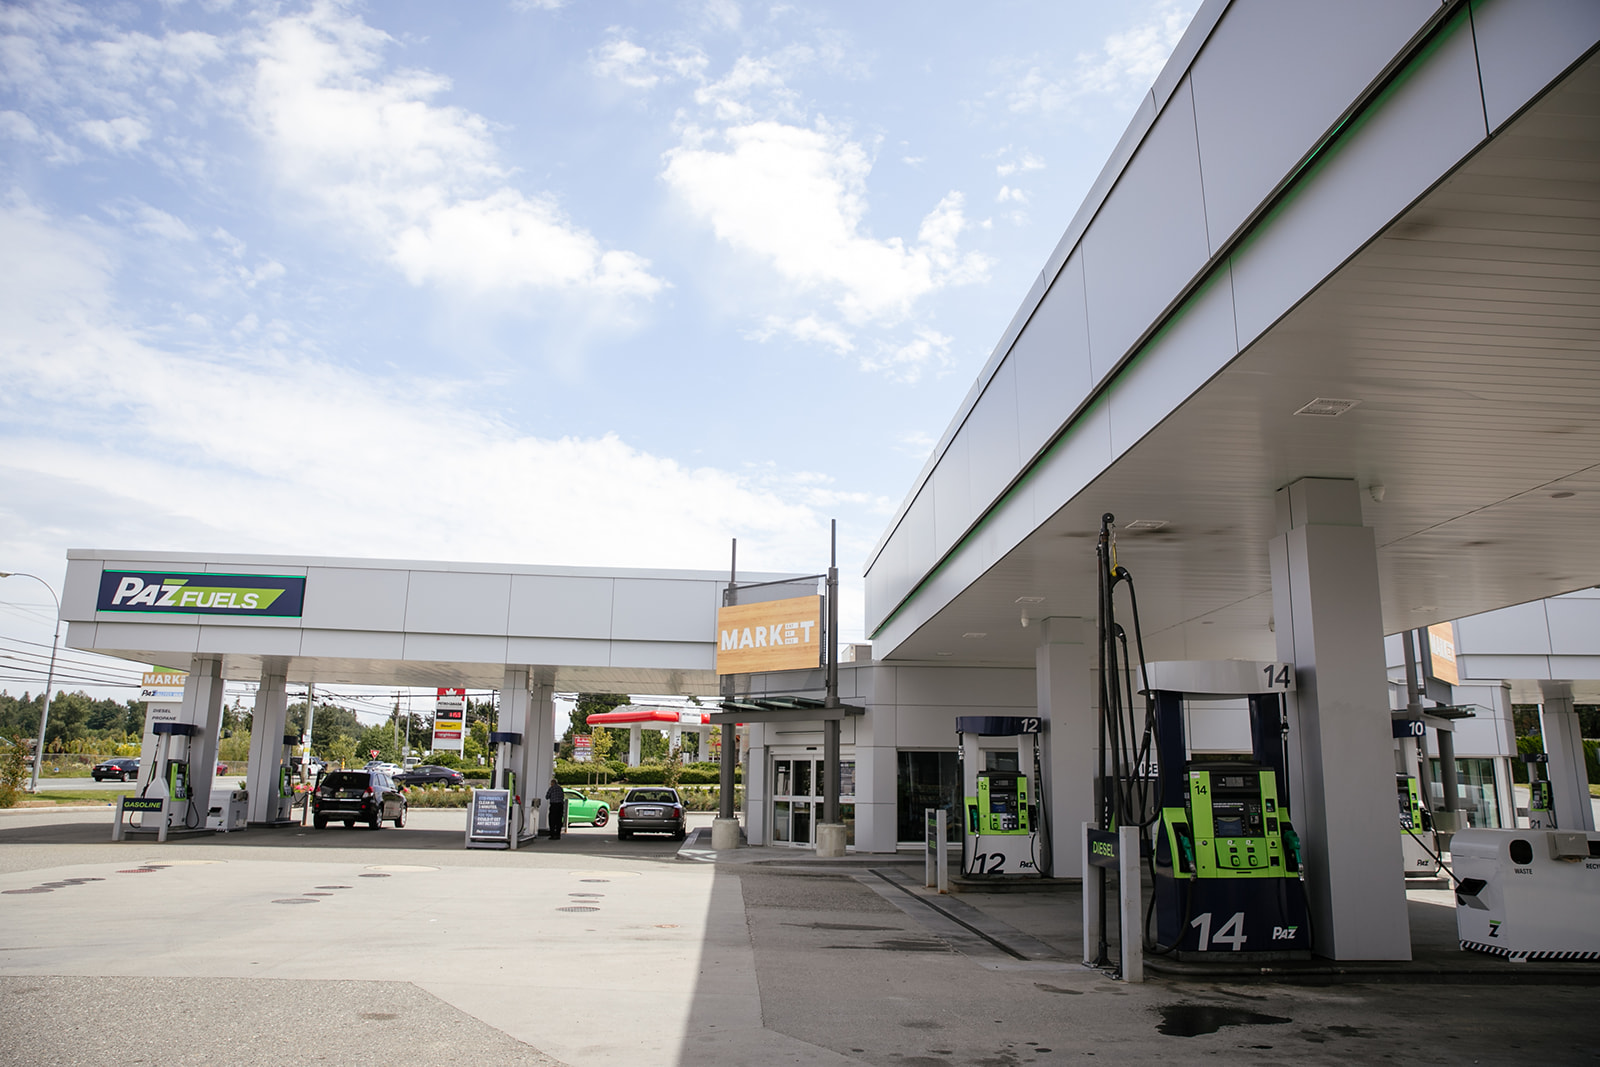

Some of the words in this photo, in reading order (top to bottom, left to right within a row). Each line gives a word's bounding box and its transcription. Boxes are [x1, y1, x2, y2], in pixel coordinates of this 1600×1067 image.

[112, 577, 188, 606] PAZ
[180, 591, 260, 609] FUELS
[721, 620, 815, 651] MARKET
[144, 674, 187, 685] MARKE
[1263, 664, 1291, 688] 14
[1021, 718, 1039, 733] 12
[1408, 721, 1424, 736] 10
[1536, 753, 1547, 762] 21
[1195, 785, 1207, 795] 14
[123, 801, 162, 809] GASOLINE
[1530, 820, 1540, 829] 21
[1093, 841, 1115, 857] DIESEL
[975, 853, 1006, 875] 12
[1190, 912, 1247, 951] 14
[1272, 926, 1298, 940] PAZ
